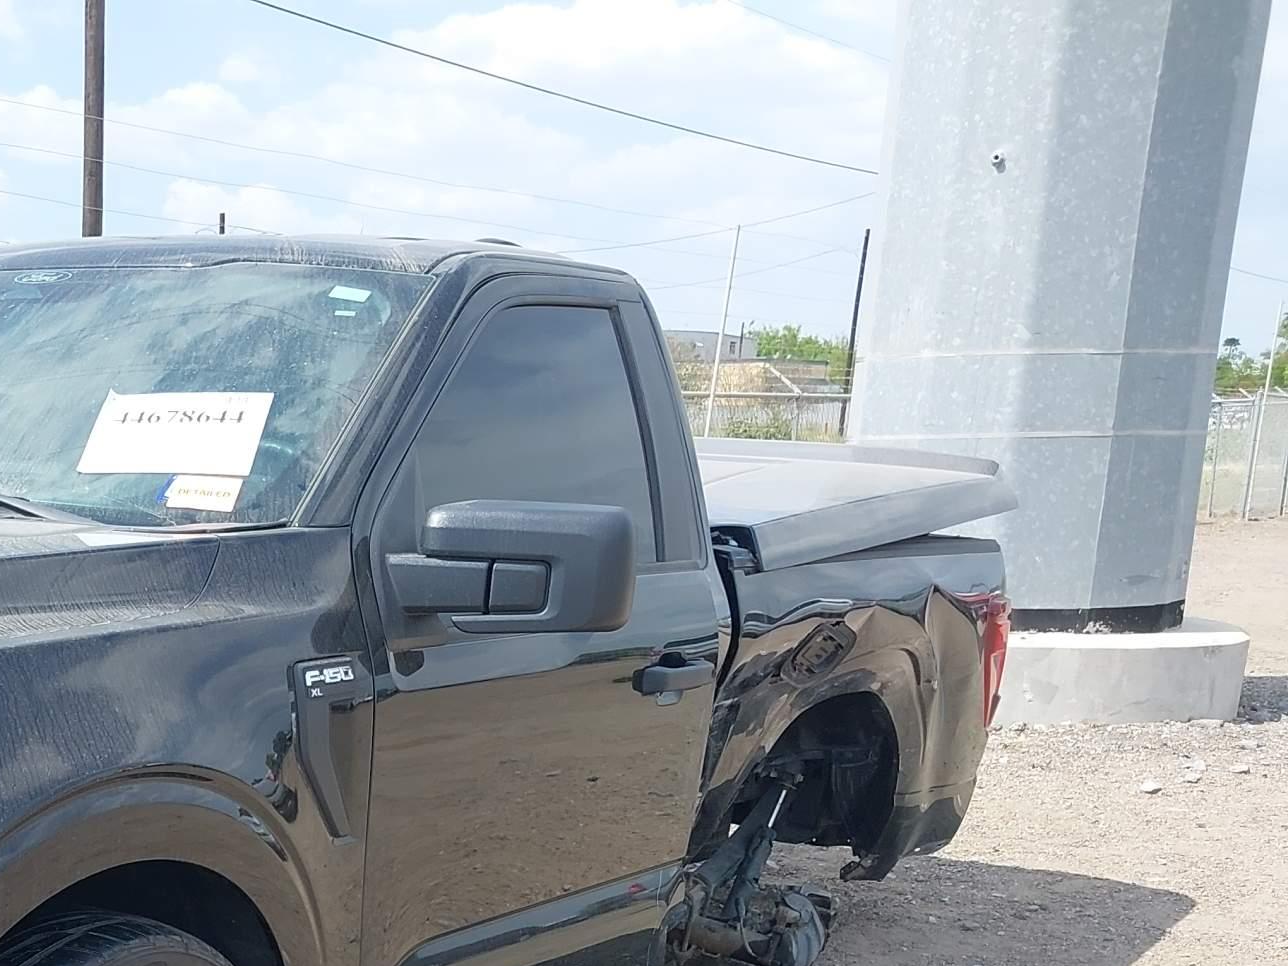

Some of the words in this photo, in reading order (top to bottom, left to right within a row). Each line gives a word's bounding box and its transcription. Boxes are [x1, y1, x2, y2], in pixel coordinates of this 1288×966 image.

[112, 410, 246, 425] 44678644
[305, 665, 354, 687] F-150
[311, 688, 324, 698] XL
